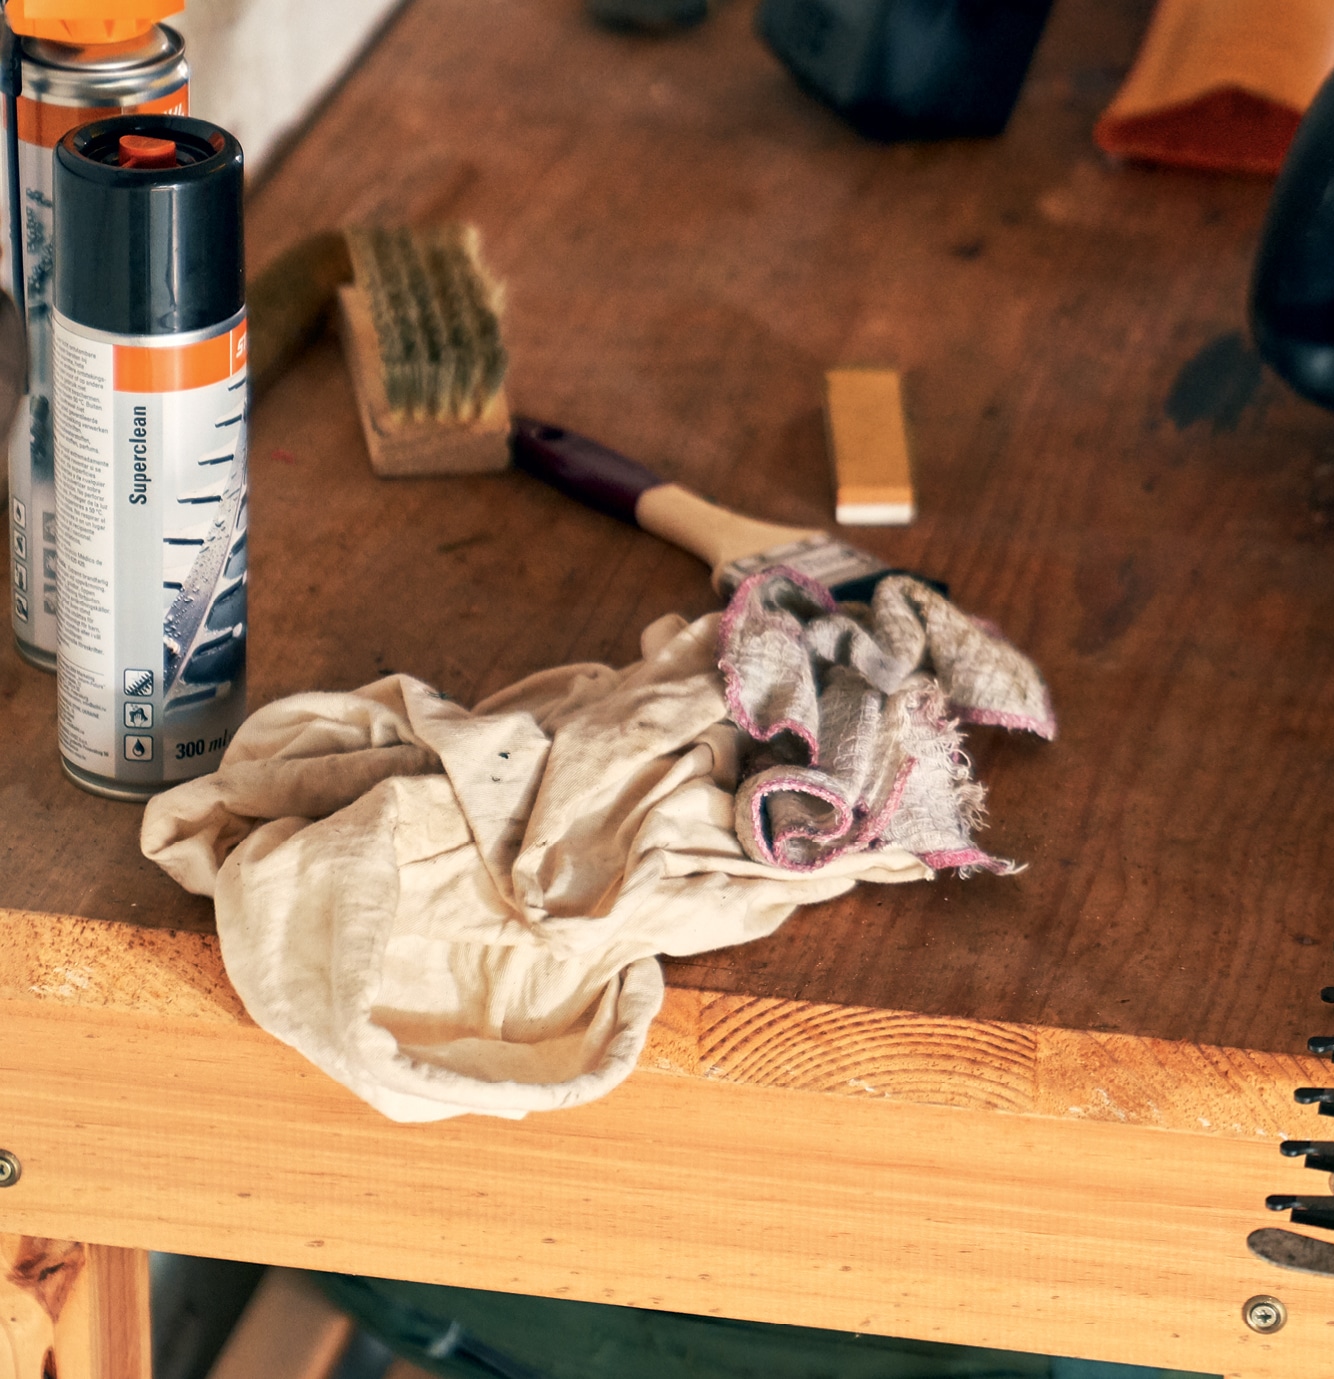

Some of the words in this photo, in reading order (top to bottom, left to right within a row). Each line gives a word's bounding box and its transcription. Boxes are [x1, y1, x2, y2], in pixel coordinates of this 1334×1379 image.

[129, 406, 152, 505] Superclean
[175, 739, 205, 760] 300
[208, 729, 227, 753] ml
